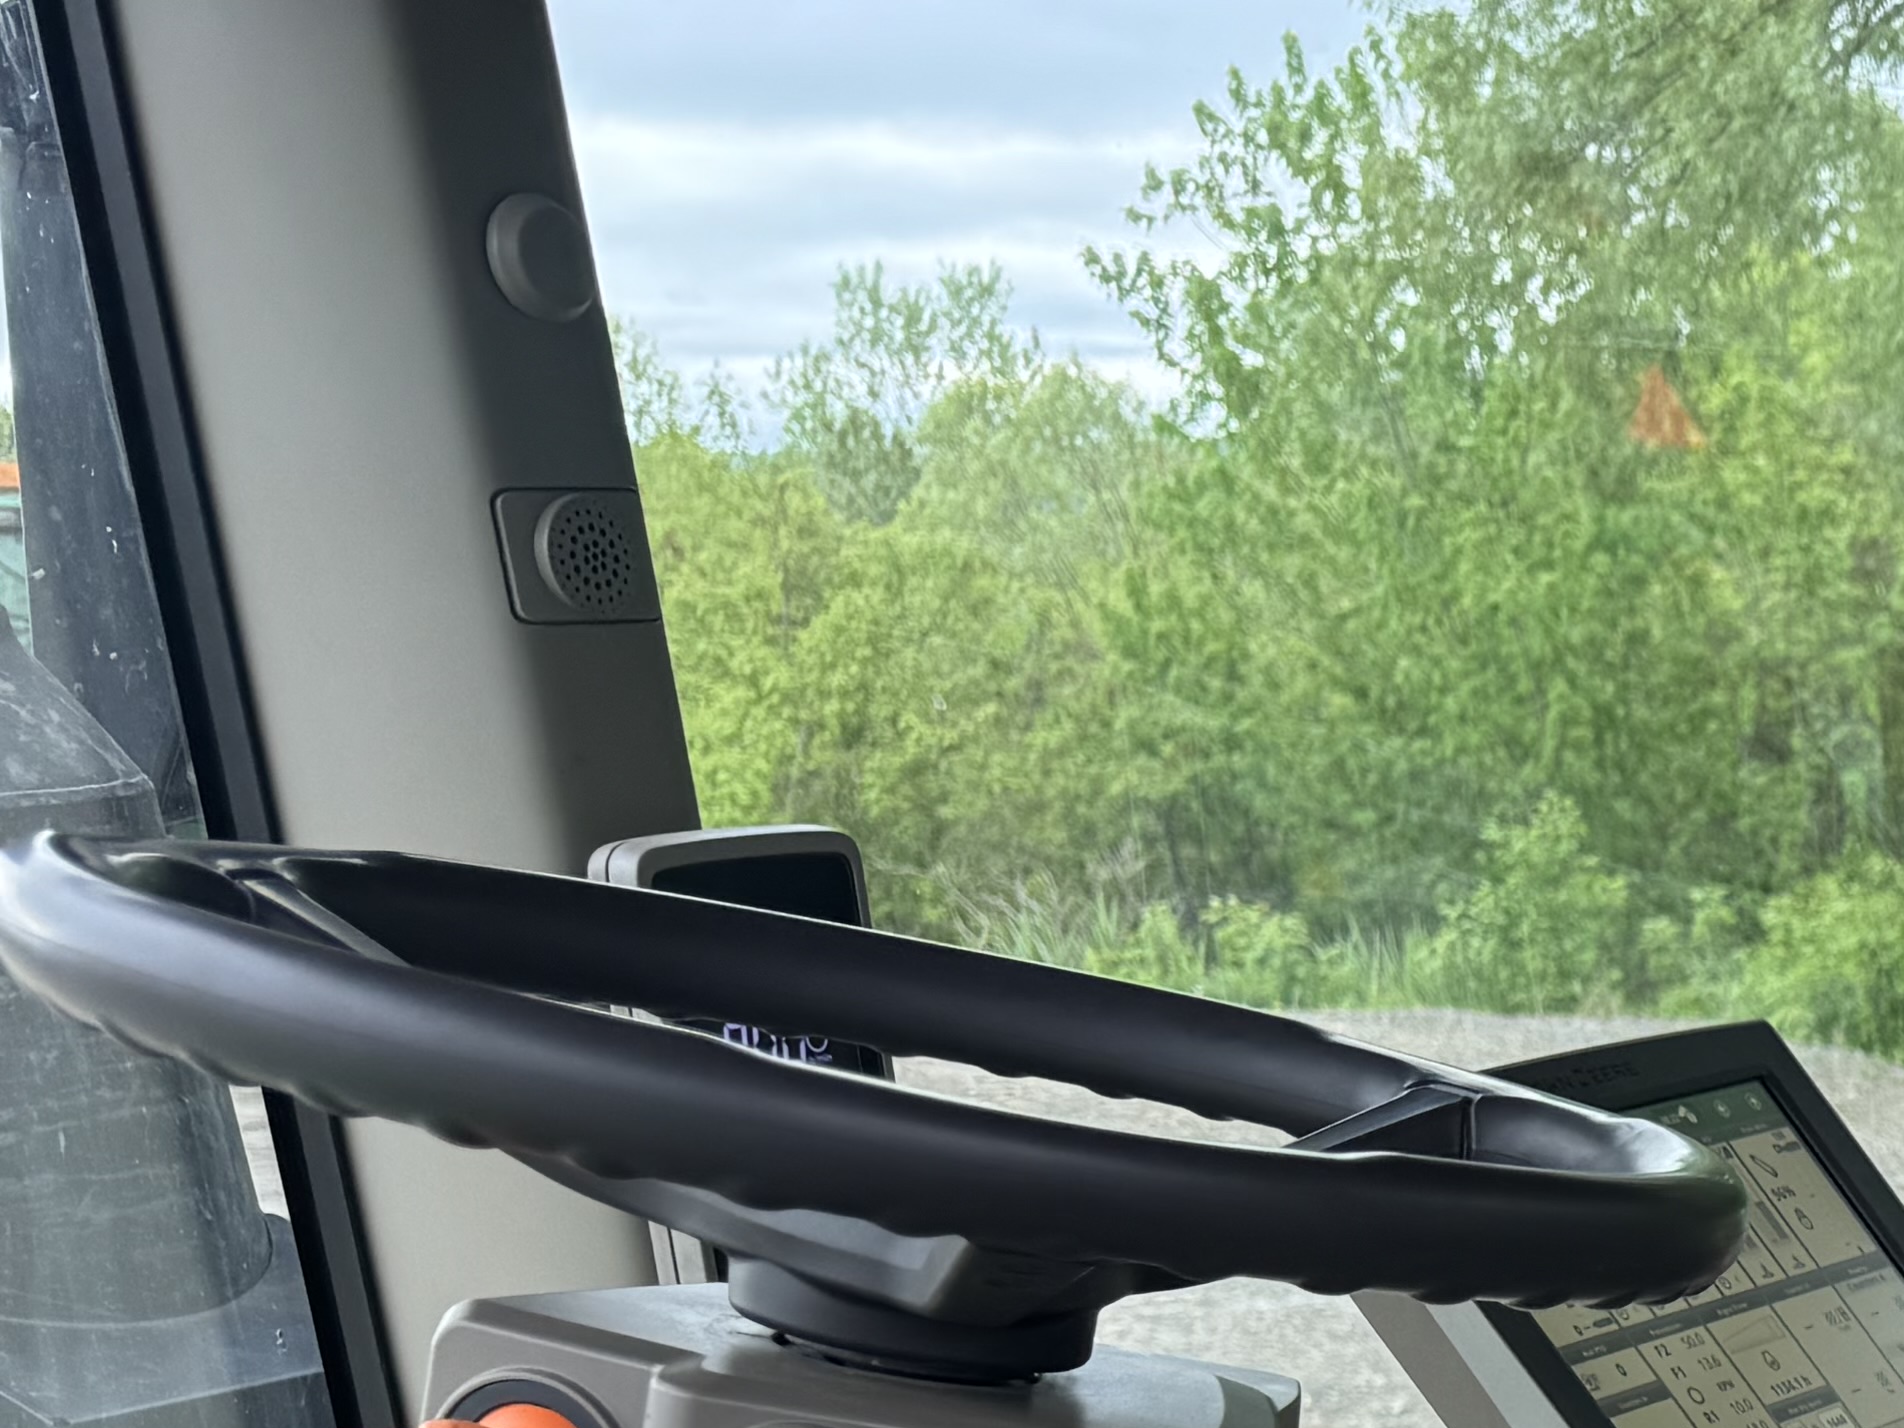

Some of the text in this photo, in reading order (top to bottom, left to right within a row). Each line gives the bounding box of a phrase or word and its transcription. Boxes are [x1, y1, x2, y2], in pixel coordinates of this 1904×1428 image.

[1655, 1344, 1671, 1357] F2
[1671, 1355, 1722, 1379] F1 13.6
[1730, 1399, 1754, 1414] 10.0
